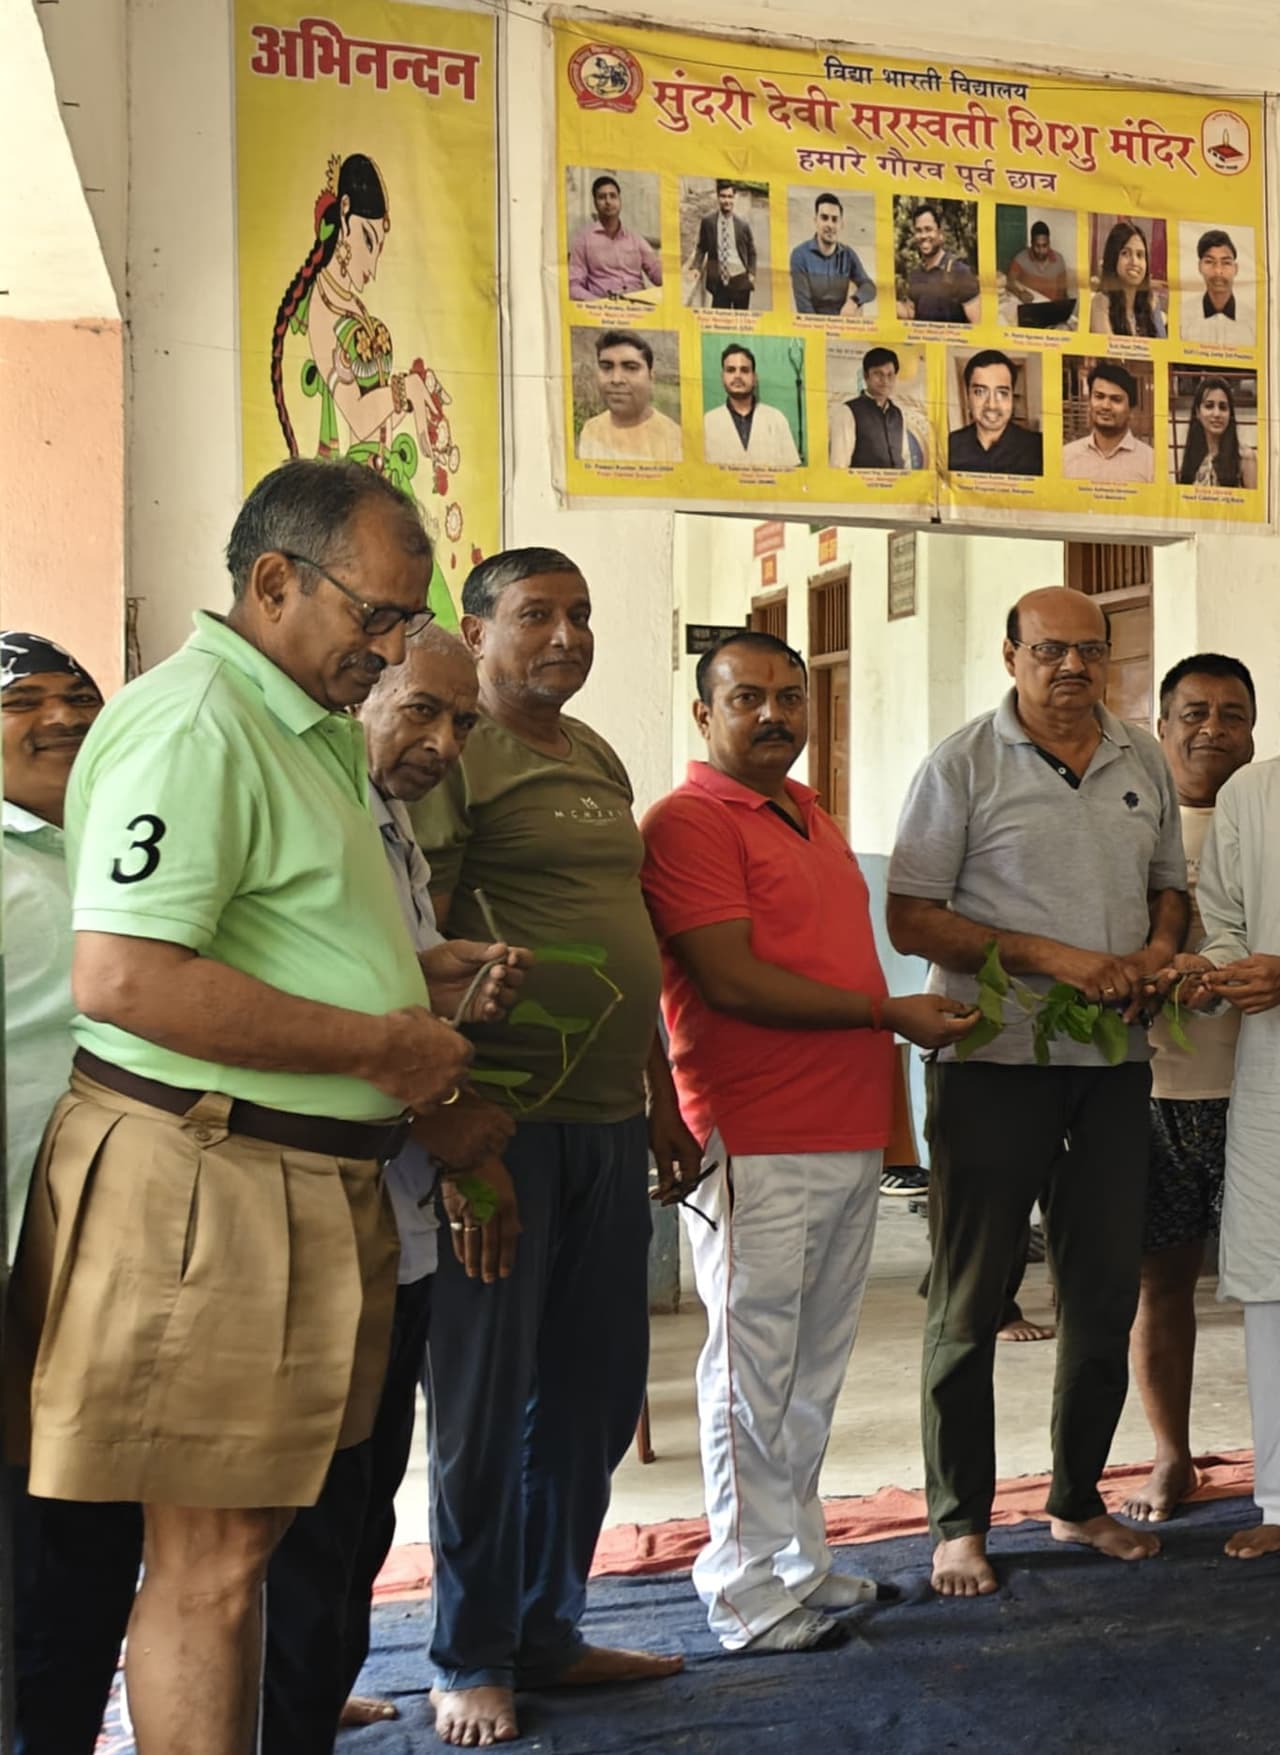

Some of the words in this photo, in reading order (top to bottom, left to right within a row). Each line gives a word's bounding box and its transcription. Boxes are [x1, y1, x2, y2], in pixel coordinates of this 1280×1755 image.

[250, 18, 480, 101] अभिनन्दन
[824, 56, 873, 84] विद्या
[882, 67, 941, 92] भारती
[950, 70, 1029, 100] विद्यालय
[652, 69, 756, 132] सुंदरी
[760, 79, 840, 134] देवी
[850, 101, 998, 150] सरस्वती
[1007, 104, 1099, 172] शिशु
[1109, 118, 1197, 175] मंदिर
[797, 146, 867, 174] हमारे
[876, 147, 944, 179] गौरव
[955, 159, 995, 192] पूर्व
[1006, 170, 1057, 191] छात्र
[110, 813, 166, 884] 3
